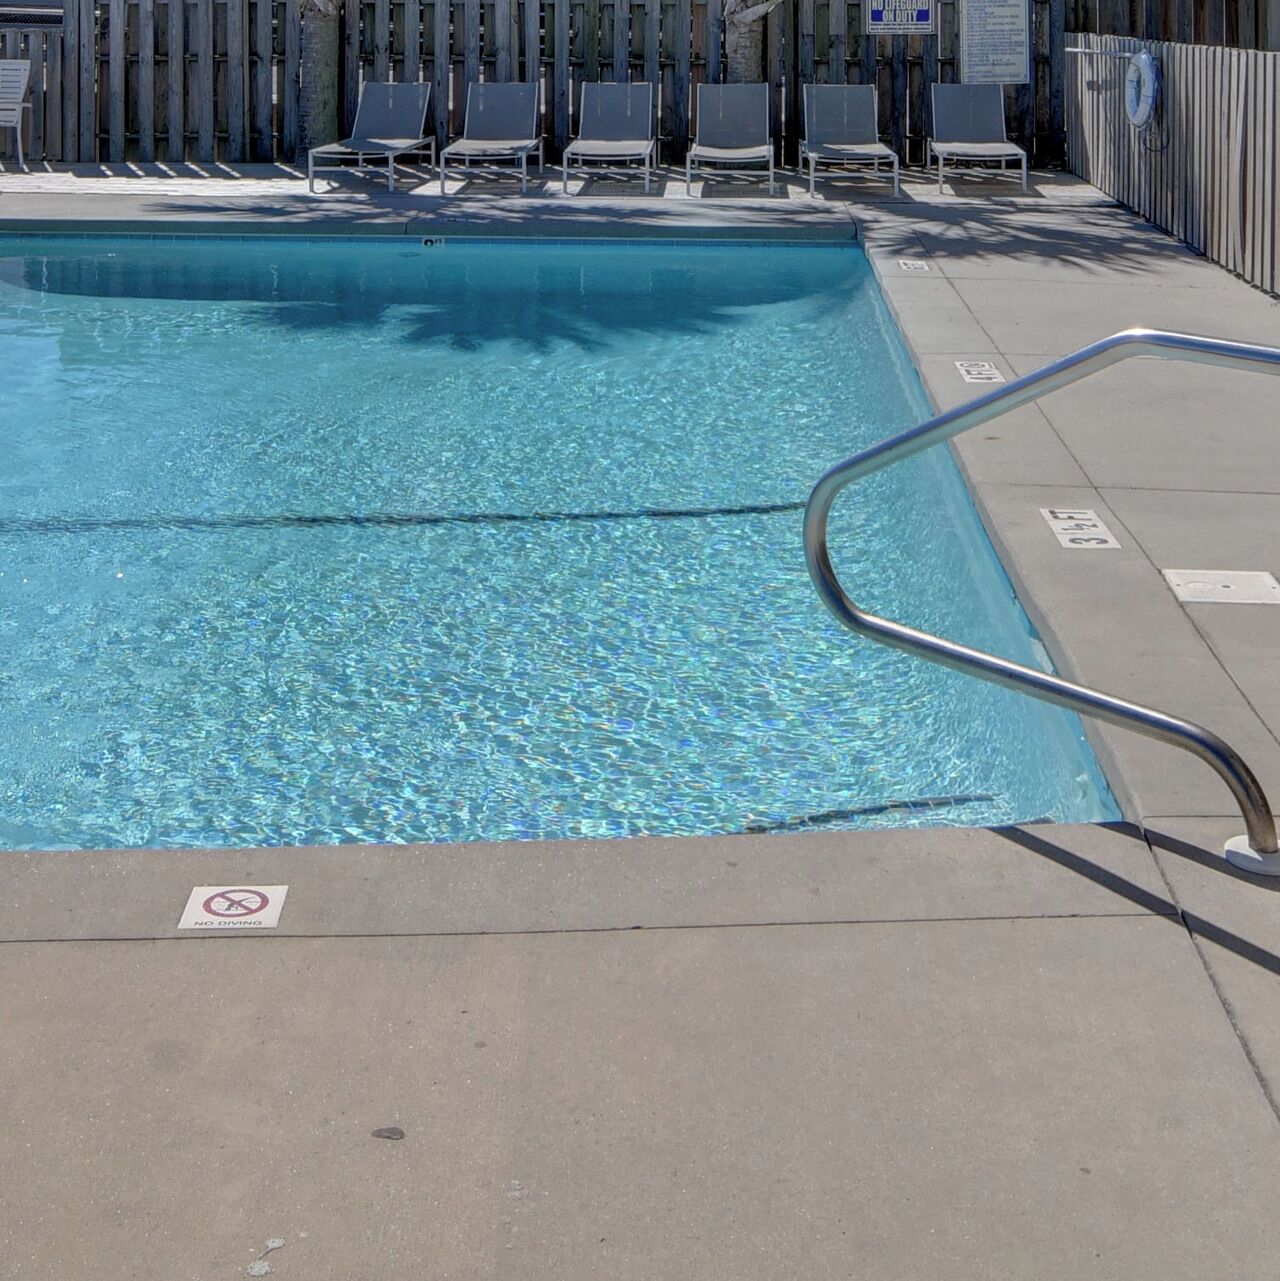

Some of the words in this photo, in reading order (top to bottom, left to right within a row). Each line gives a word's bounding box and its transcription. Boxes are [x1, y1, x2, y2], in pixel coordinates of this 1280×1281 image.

[872, 0, 883, 10] NO
[885, 0, 929, 10] LIFEGUARD
[883, 10, 894, 22] ON
[896, 10, 917, 22] DUTY
[1048, 509, 1094, 521] FT
[1069, 537, 1109, 545] 3
